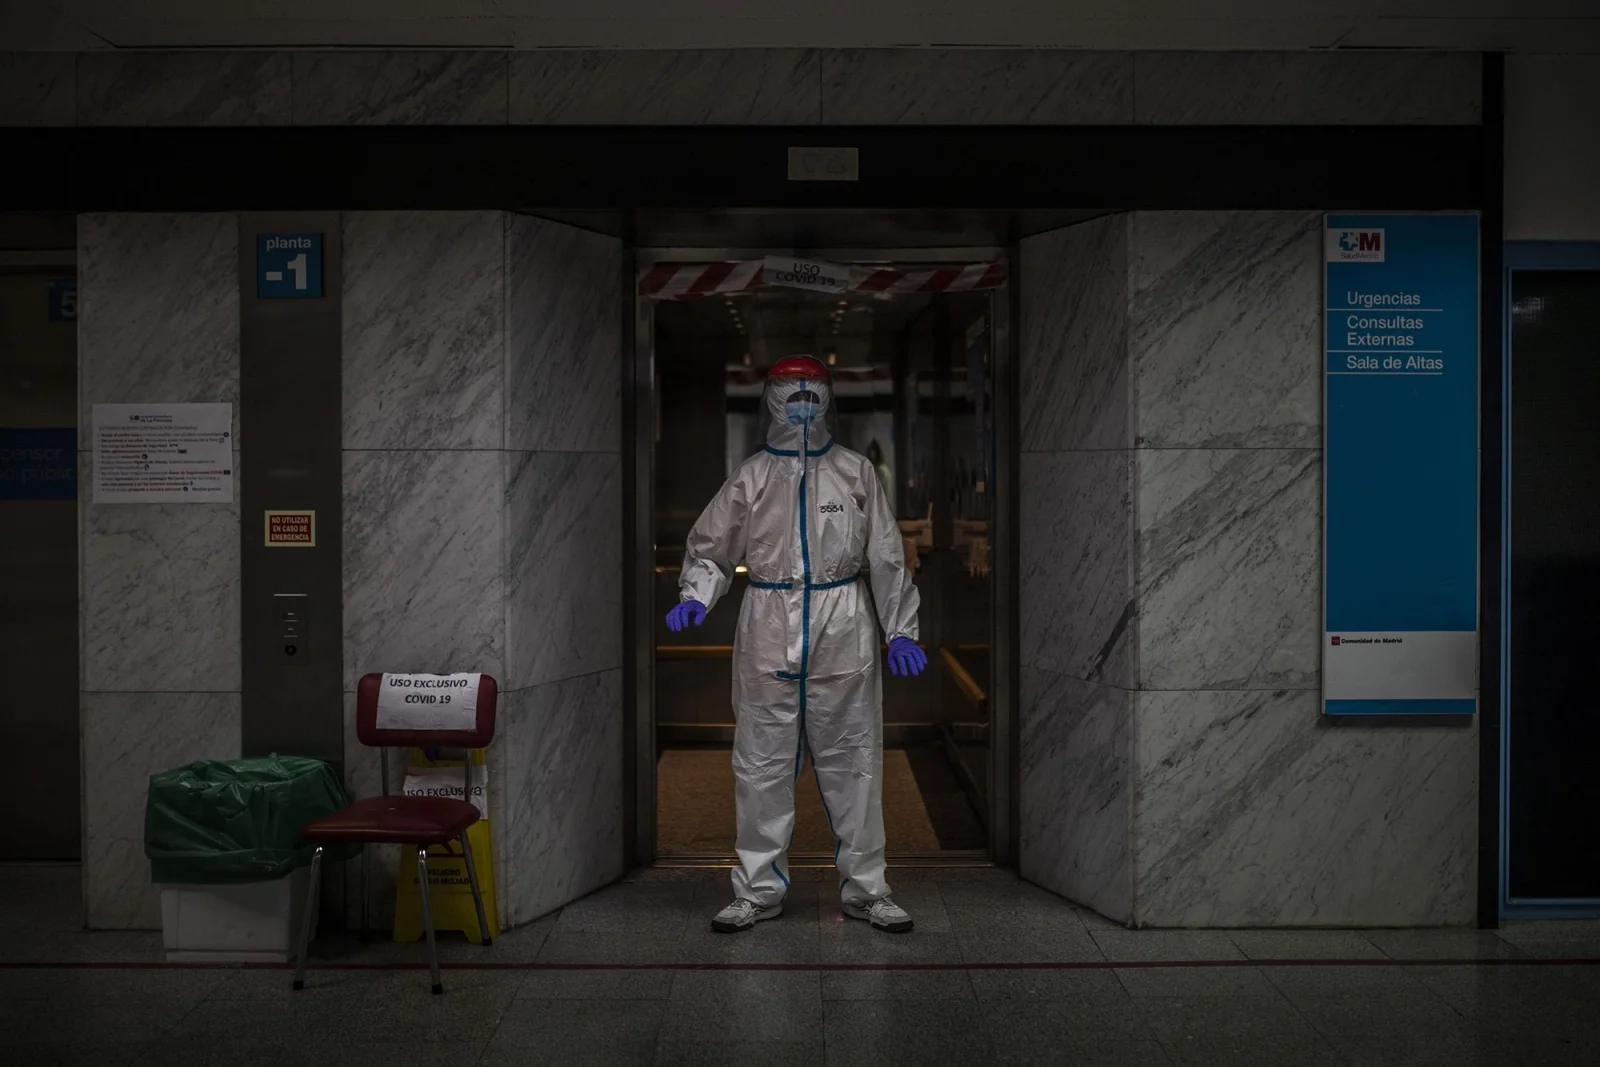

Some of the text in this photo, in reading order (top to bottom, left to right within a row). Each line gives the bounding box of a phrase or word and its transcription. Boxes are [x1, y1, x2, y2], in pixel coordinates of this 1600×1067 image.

[266, 236, 312, 252] planta
[1359, 232, 1381, 251] M
[265, 253, 307, 290] -1
[794, 263, 820, 276] USO
[776, 271, 836, 286] COVID 19
[1347, 291, 1421, 308] Urgencias
[1346, 315, 1424, 329] Consultas
[1347, 332, 1415, 346] Externas
[1346, 355, 1444, 370] Sala de Altas
[20, 463, 76, 484] públic
[271, 516, 309, 524] NO UTILIZAR
[271, 533, 310, 541] EMERGENCIA
[389, 678, 468, 688] USO EXCLUSIVO
[405, 694, 451, 704] COVID 19
[427, 786, 482, 797] EXCLUSO
[427, 868, 461, 876] PELIGRO
